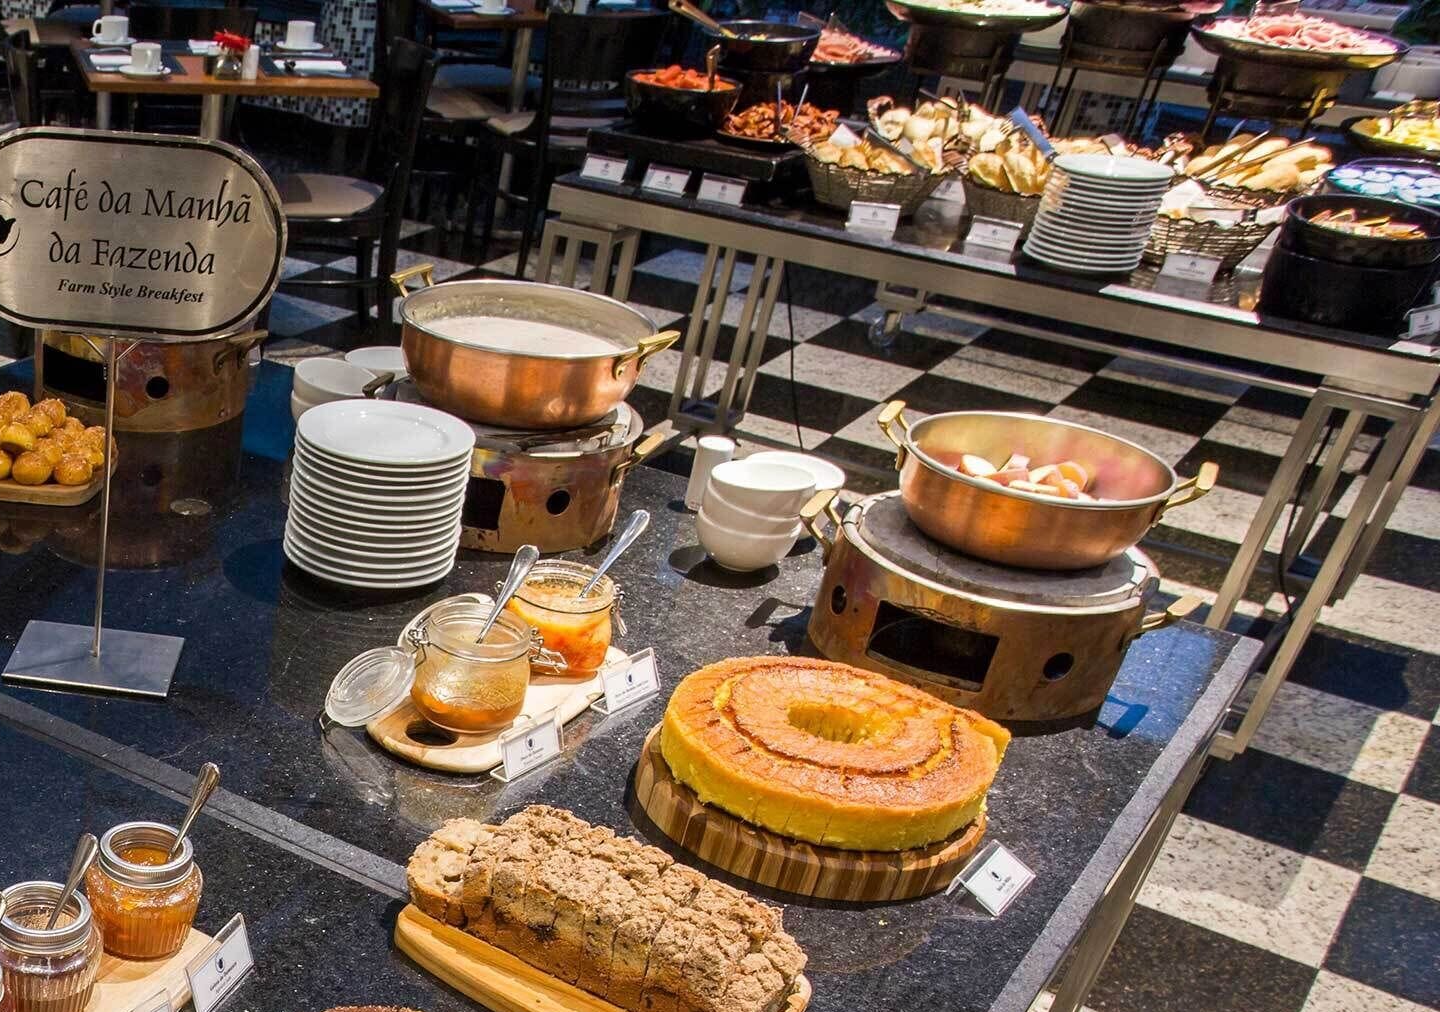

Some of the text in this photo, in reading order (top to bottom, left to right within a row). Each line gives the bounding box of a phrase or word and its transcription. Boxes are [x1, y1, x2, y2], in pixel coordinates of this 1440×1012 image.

[20, 168, 252, 228] Café da Manhã
[48, 231, 216, 275] da Fazenda
[57, 279, 204, 304] Farm Style Breakfest
